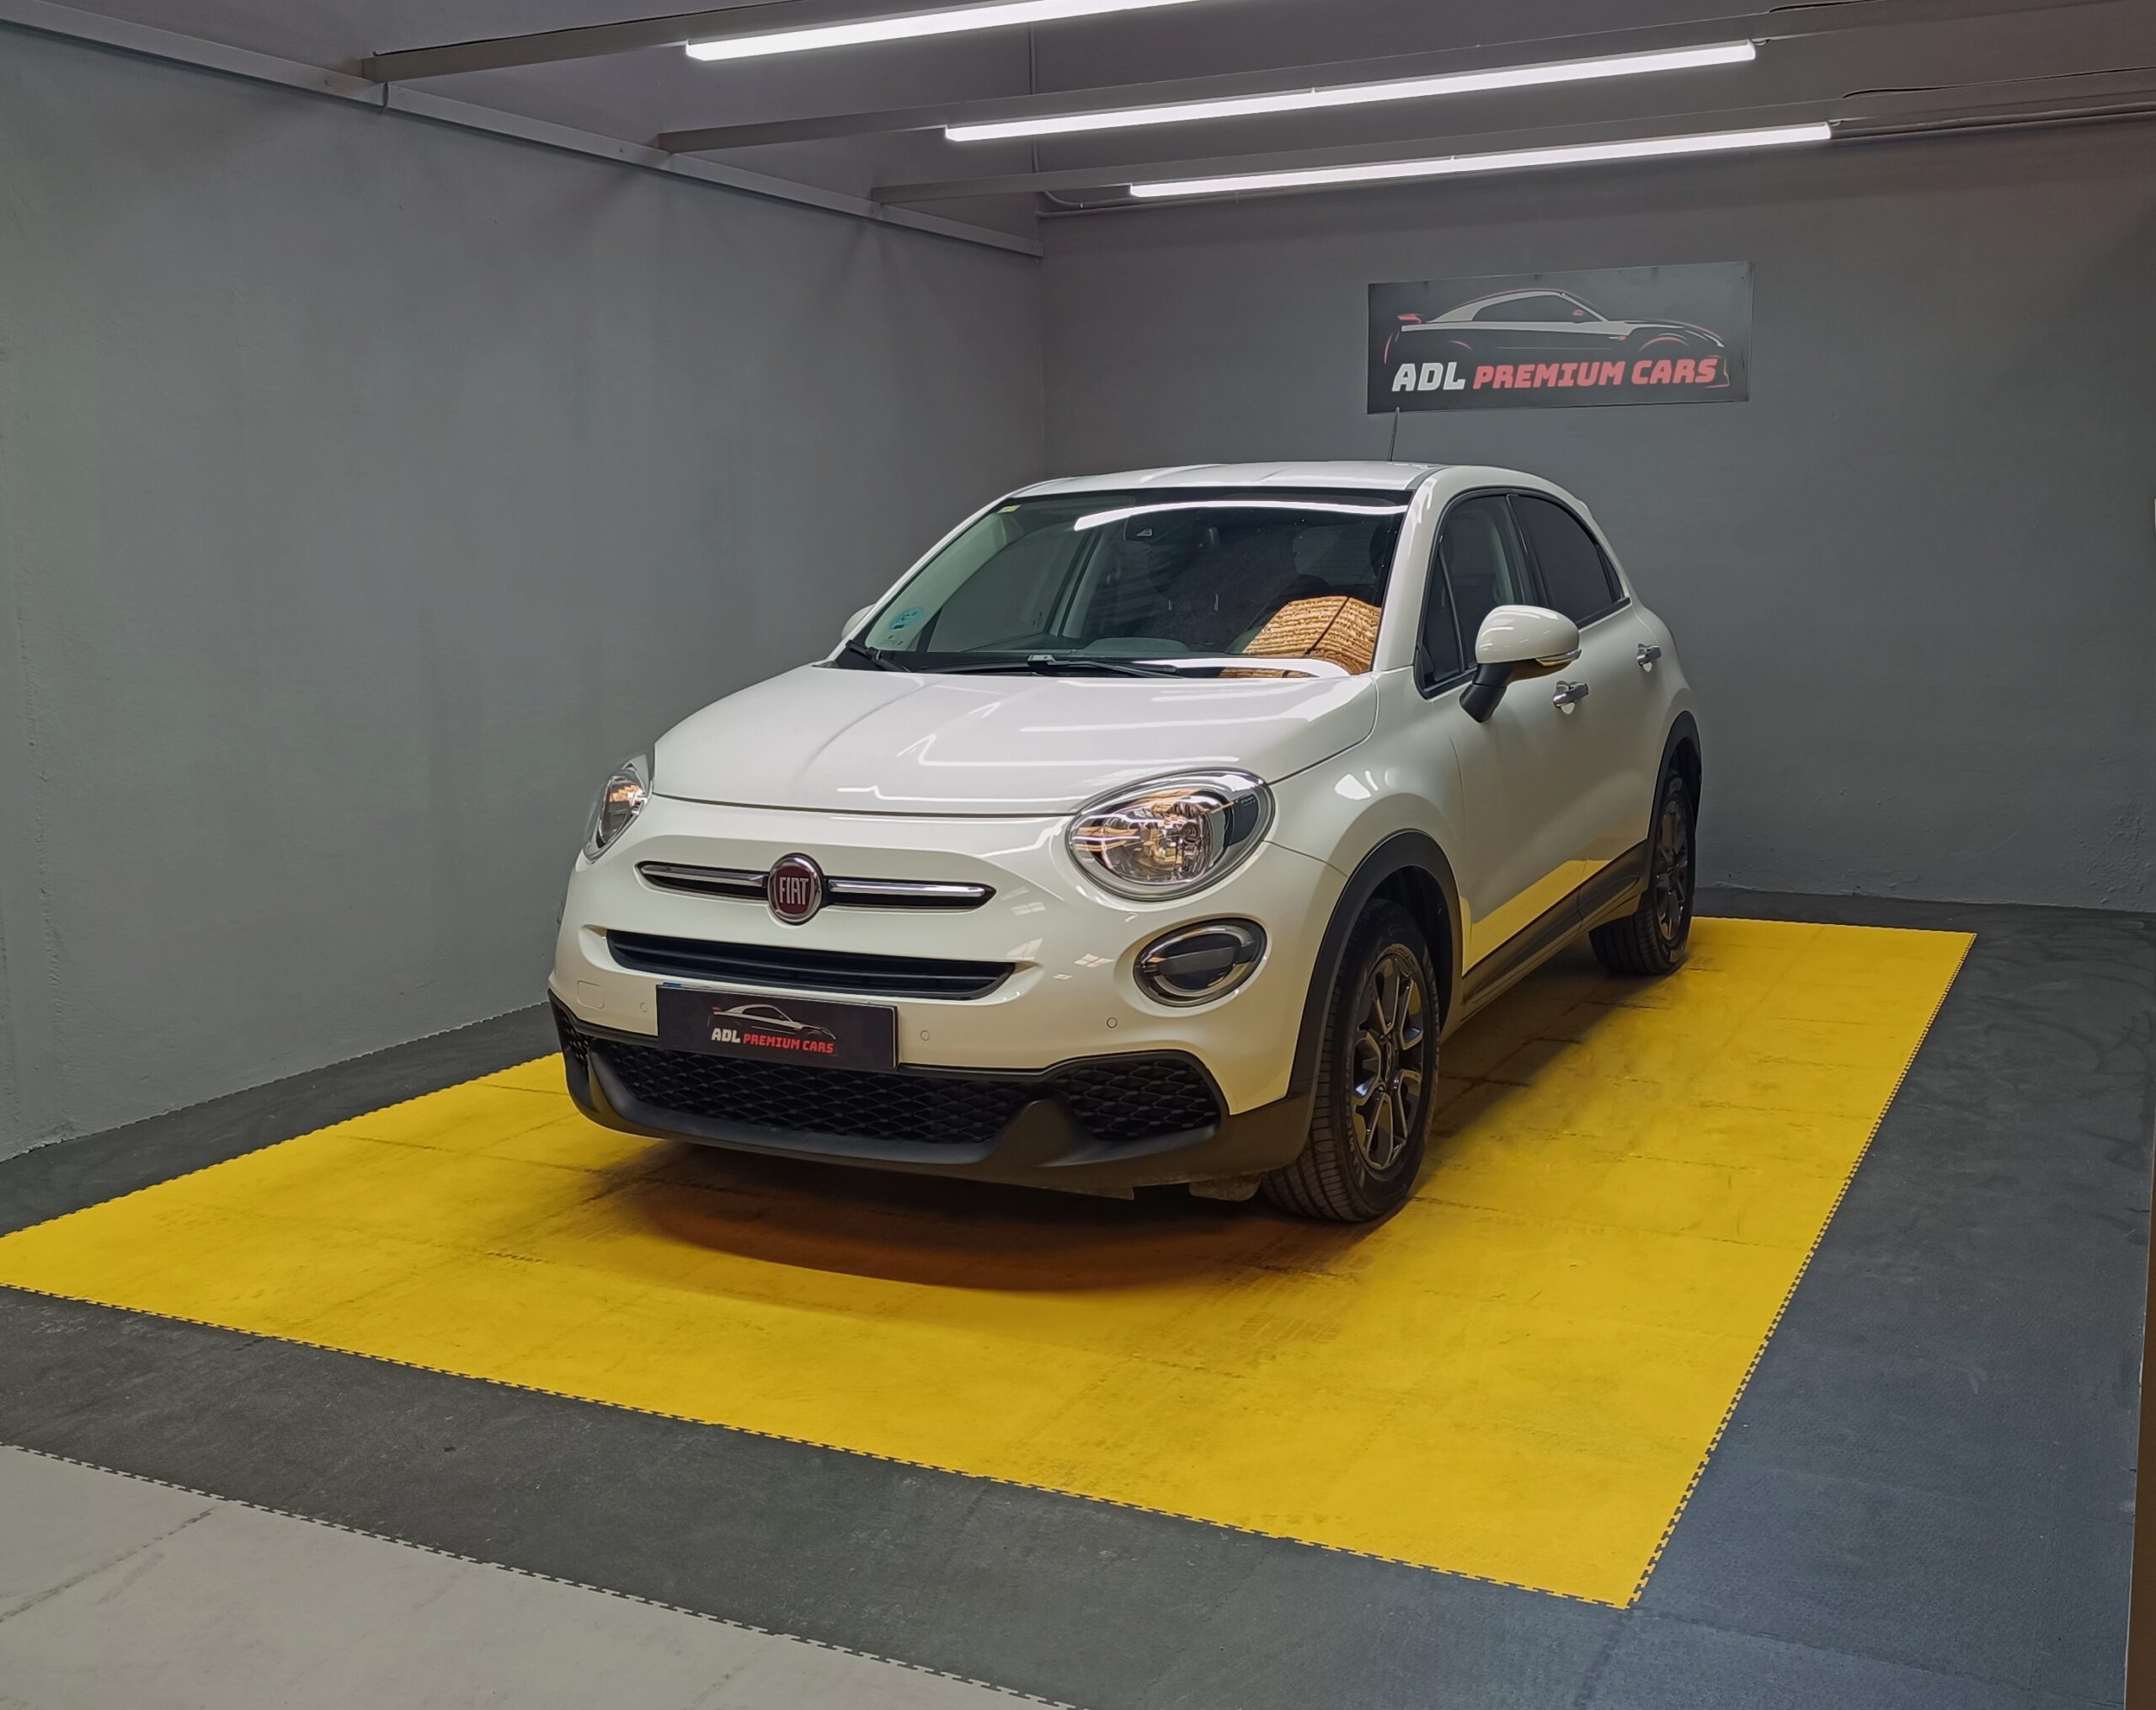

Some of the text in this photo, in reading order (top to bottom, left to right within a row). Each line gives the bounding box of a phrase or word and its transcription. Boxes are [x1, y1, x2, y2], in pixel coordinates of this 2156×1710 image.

[1392, 358, 1718, 392] ADL PREMIUM CARS
[779, 876, 808, 905] FIAT
[711, 1028, 834, 1054] ADL PREMIUM CARS
[1345, 1057, 1356, 1152] MICHELIN
